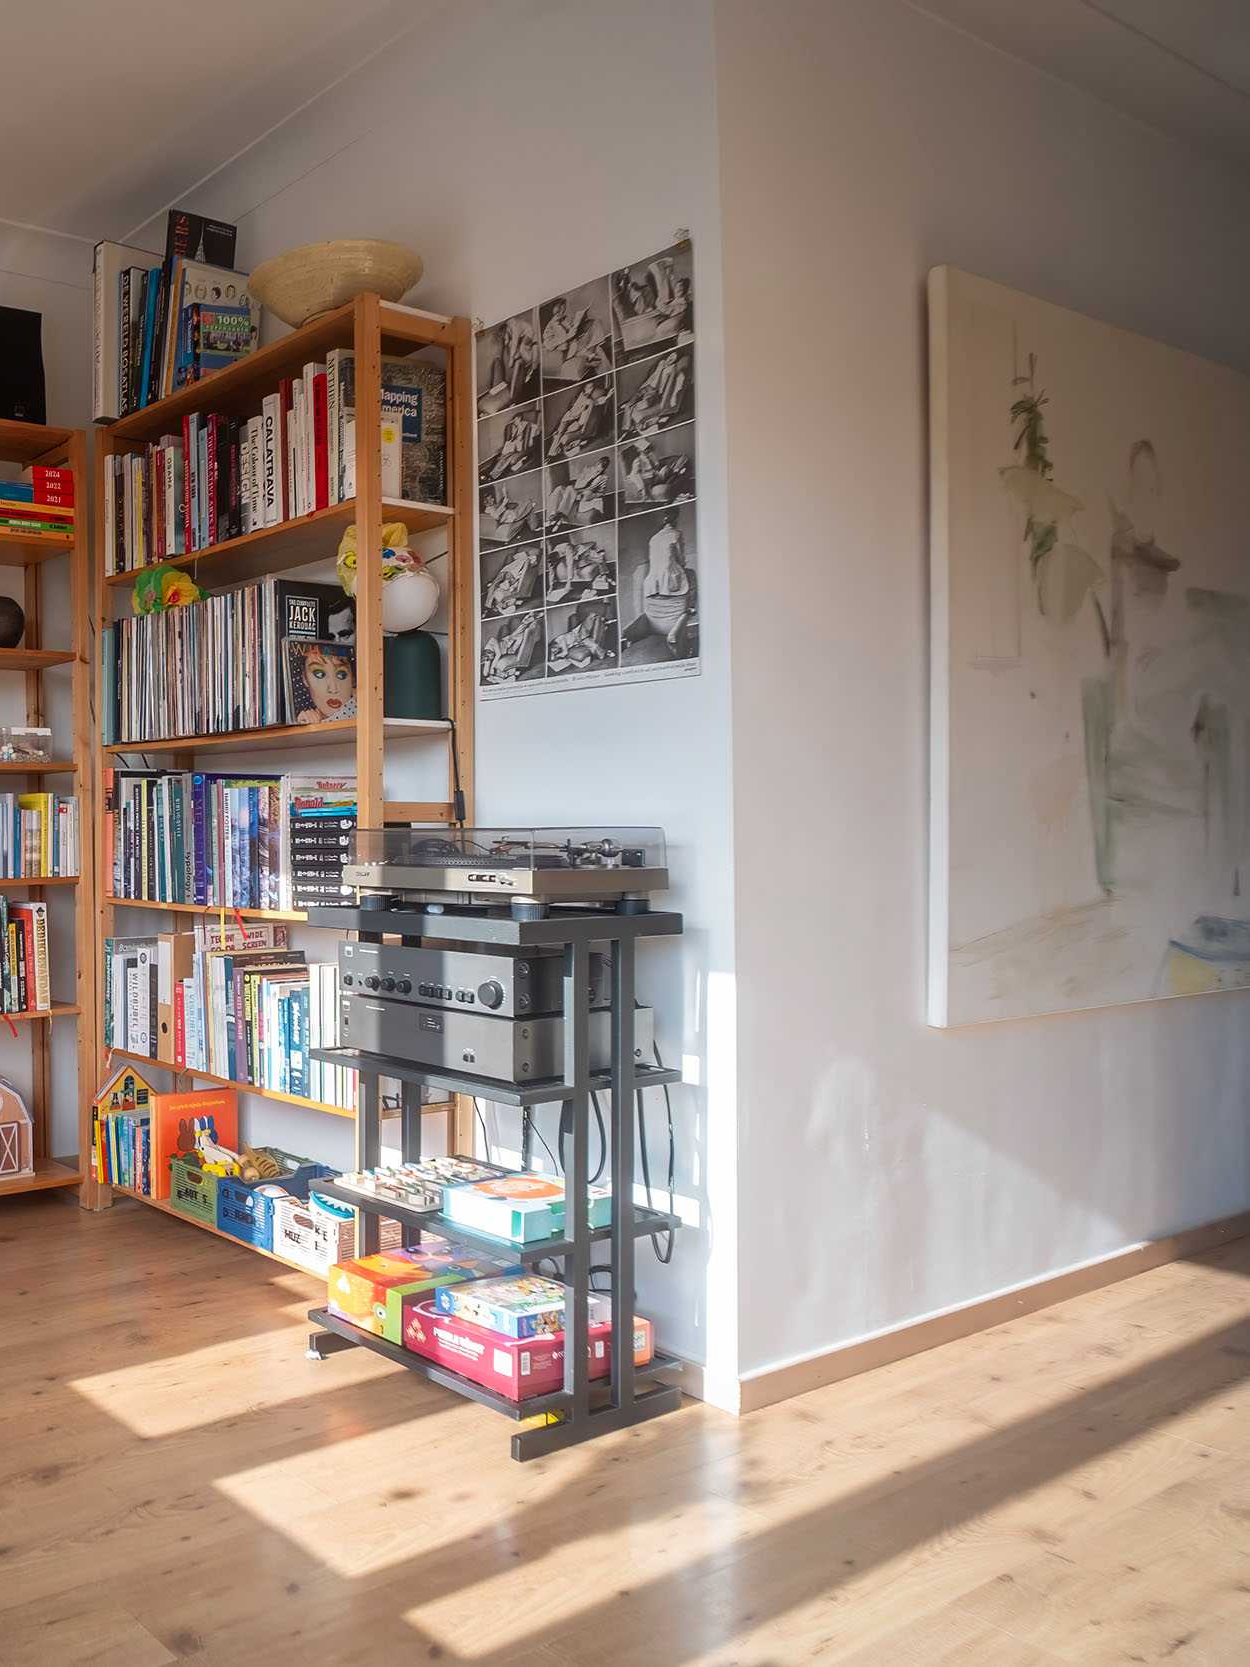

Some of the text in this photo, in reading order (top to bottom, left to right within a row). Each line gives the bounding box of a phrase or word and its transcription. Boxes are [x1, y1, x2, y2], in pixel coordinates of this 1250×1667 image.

[121, 295, 130, 348] WERELD
[217, 315, 250, 326] 100%
[120, 350, 129, 412] BOSATLAS
[328, 358, 338, 410] MYTHEN
[382, 389, 418, 406] apping
[382, 404, 418, 419] merica
[250, 428, 259, 446] The
[266, 416, 275, 508] CALATRAVA
[167, 457, 175, 490] OSAMA
[240, 442, 250, 505] DESIGN
[46, 481, 62, 490] 2022
[46, 494, 62, 504] 2021
[289, 605, 316, 622] JACK
[289, 621, 316, 630] KEROUAC
[185, 852, 193, 893] typology
[242, 941, 267, 950] SCREEN
